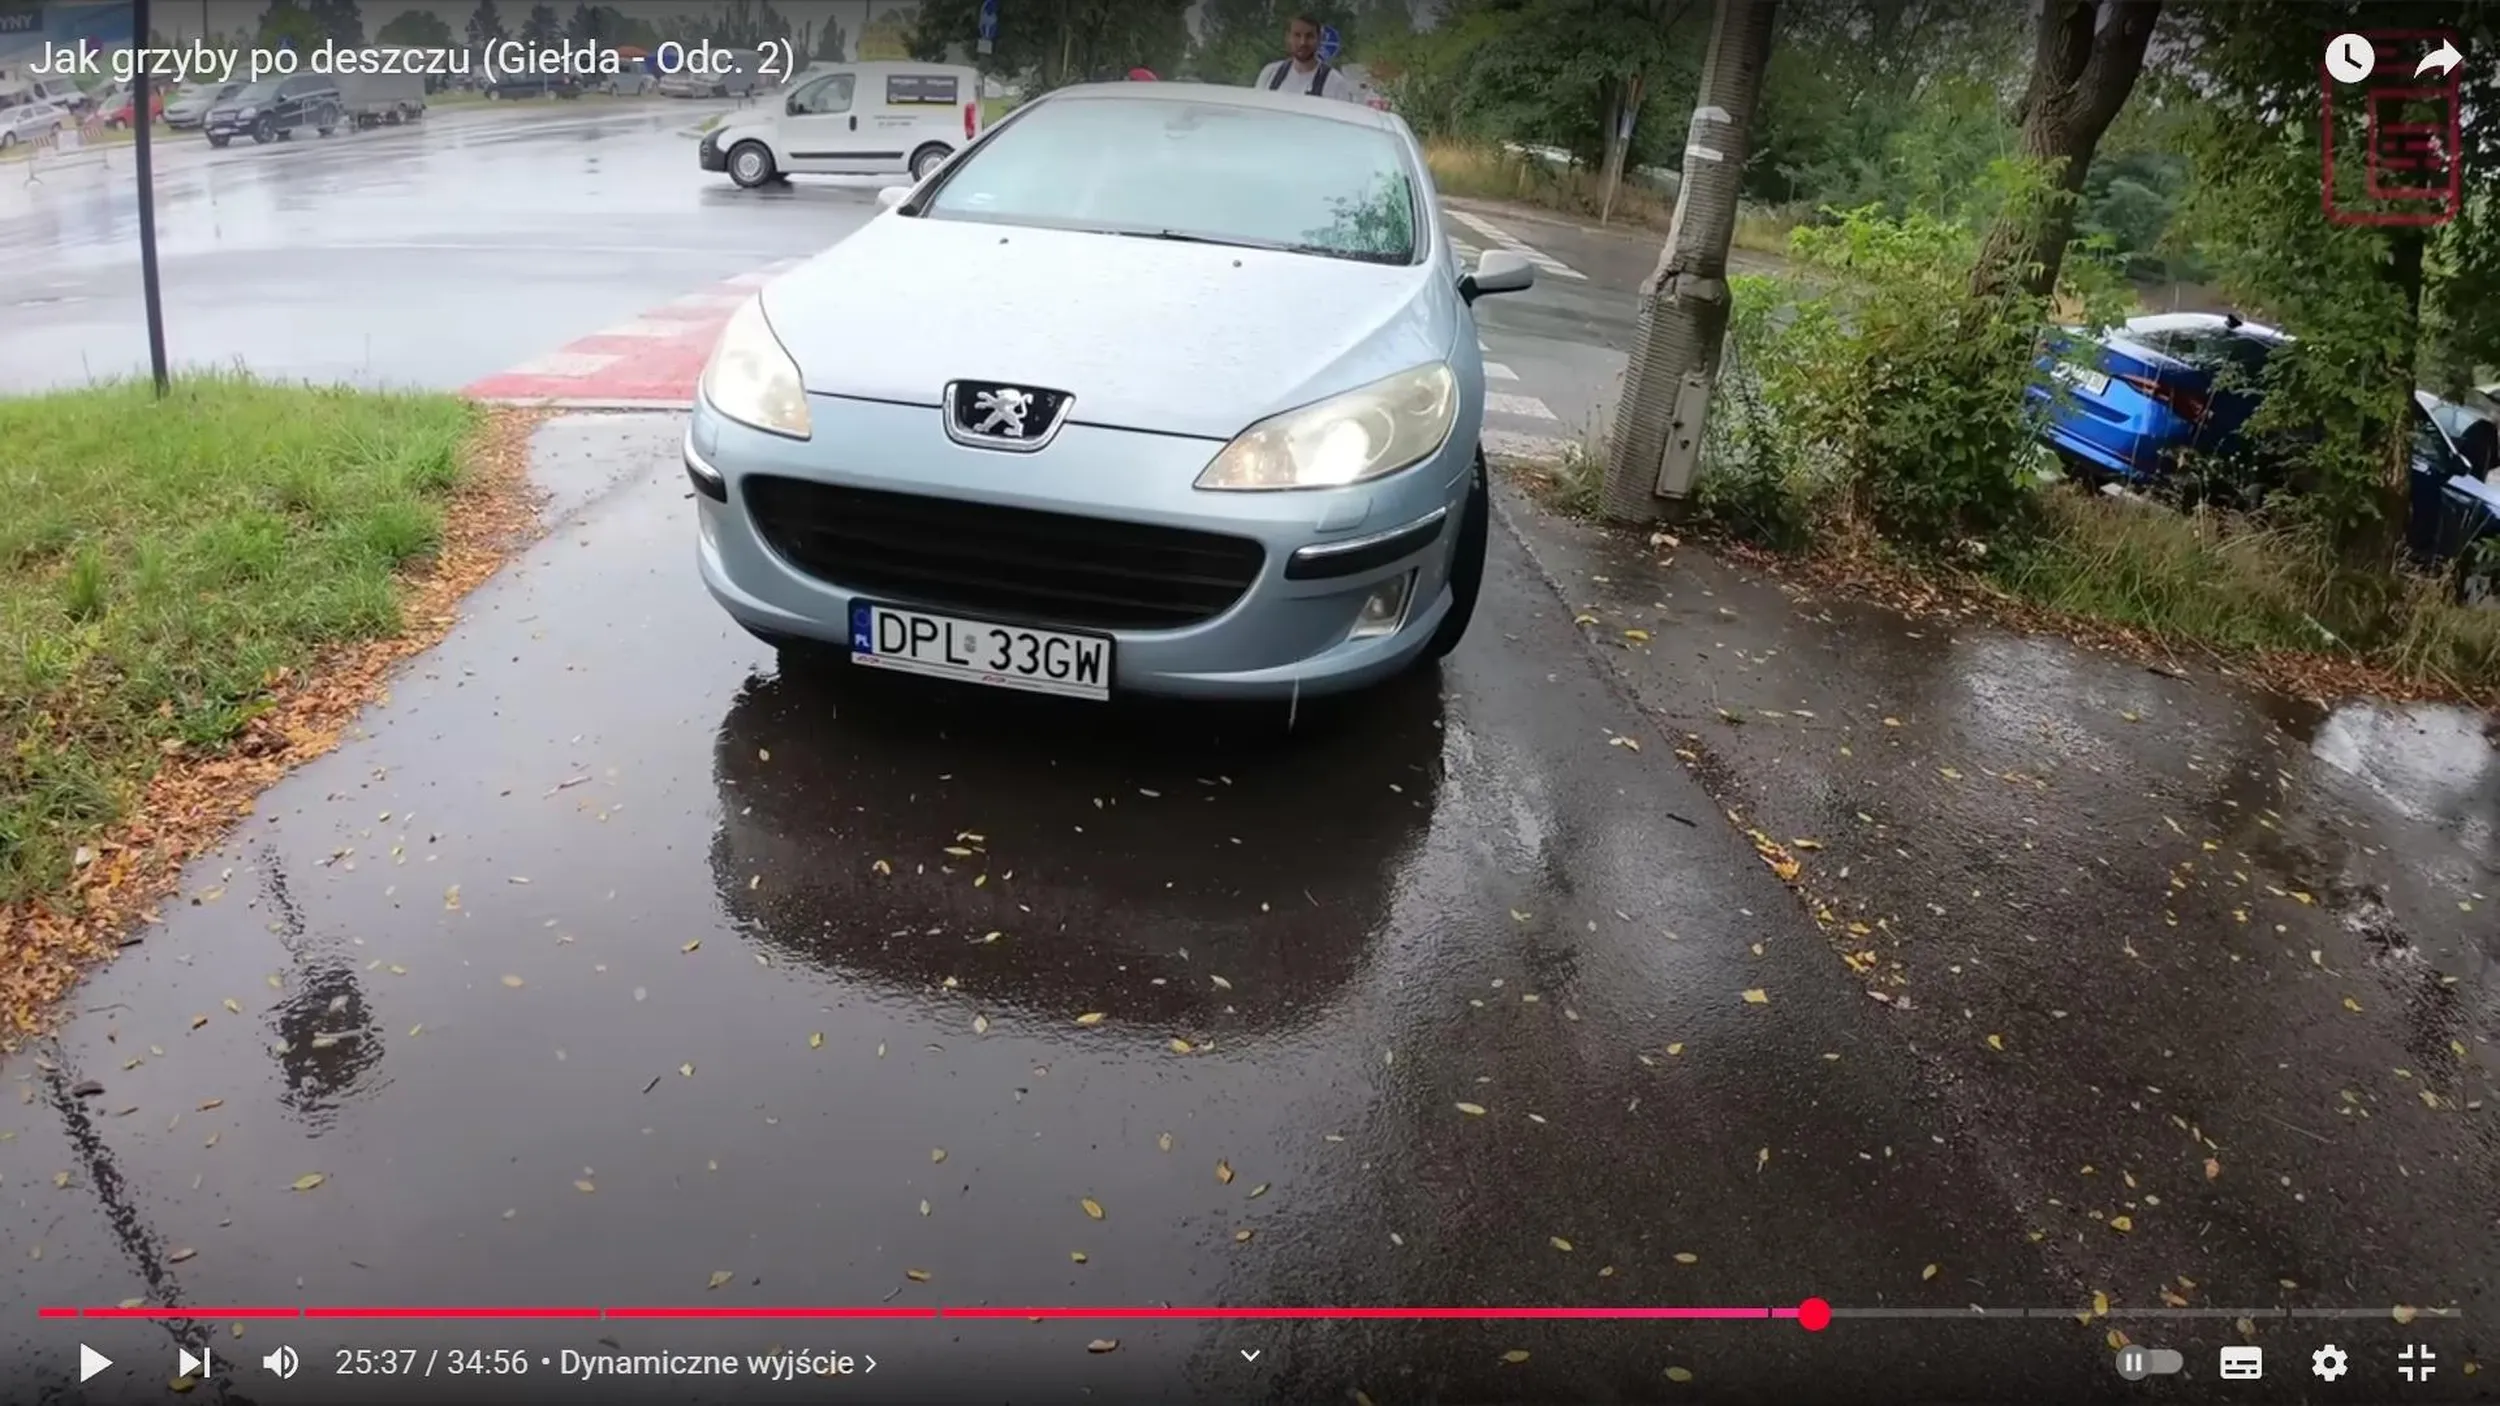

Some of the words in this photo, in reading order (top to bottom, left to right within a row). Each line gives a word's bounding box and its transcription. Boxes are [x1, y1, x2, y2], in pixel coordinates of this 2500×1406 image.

[854, 633, 869, 647] PL
[879, 612, 969, 666] DPL
[989, 629, 1102, 684] 33GW
